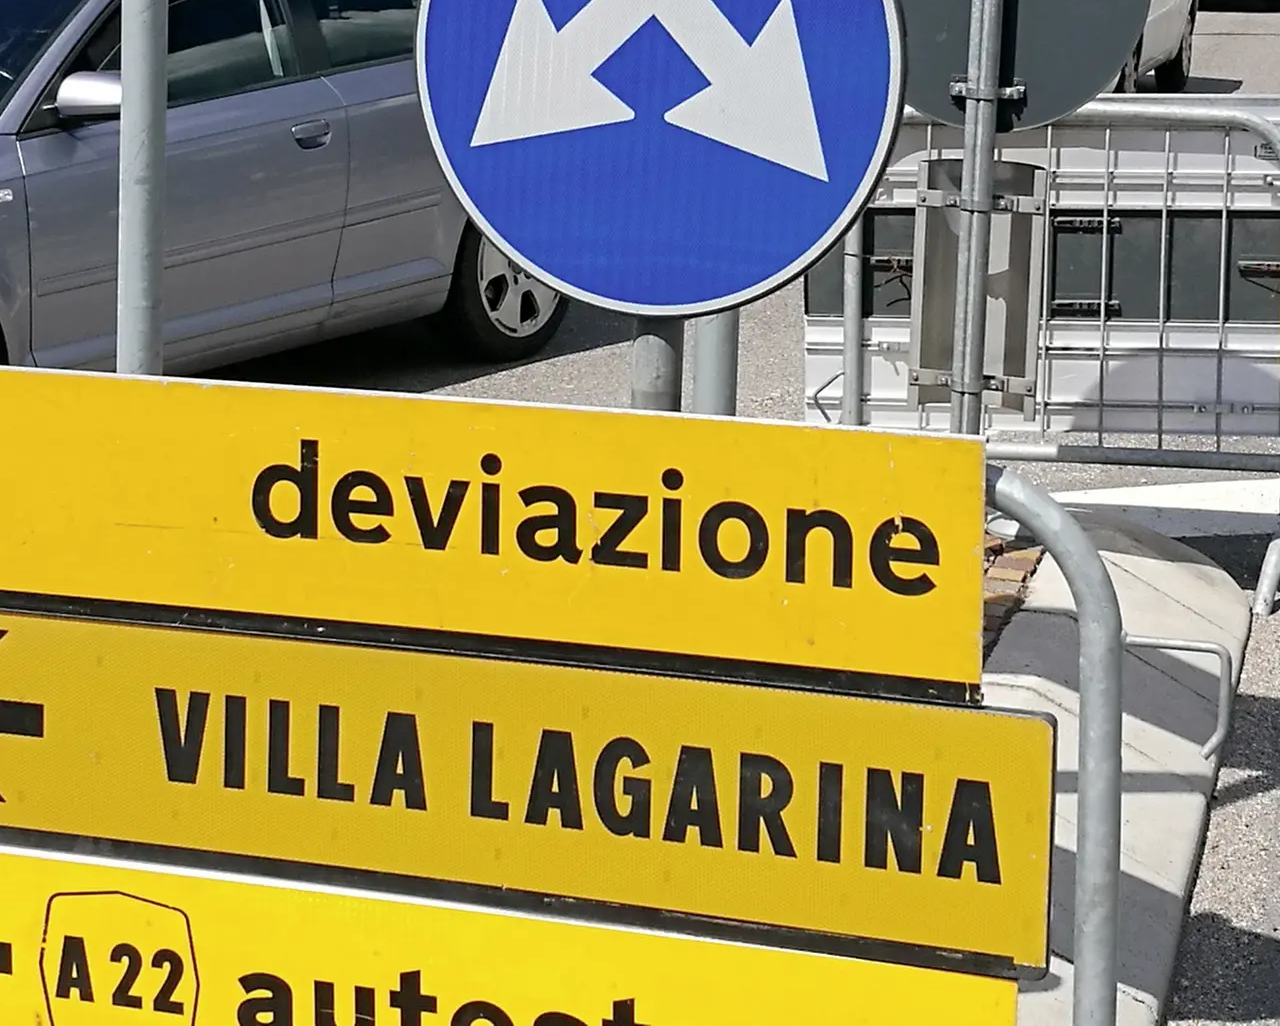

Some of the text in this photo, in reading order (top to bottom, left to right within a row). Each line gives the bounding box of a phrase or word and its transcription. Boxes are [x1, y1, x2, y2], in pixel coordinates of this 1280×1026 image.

[251, 439, 940, 596] deviazione
[154, 687, 1002, 885] VILLA LAGARINA
[237, 970, 651, 1026] aut
